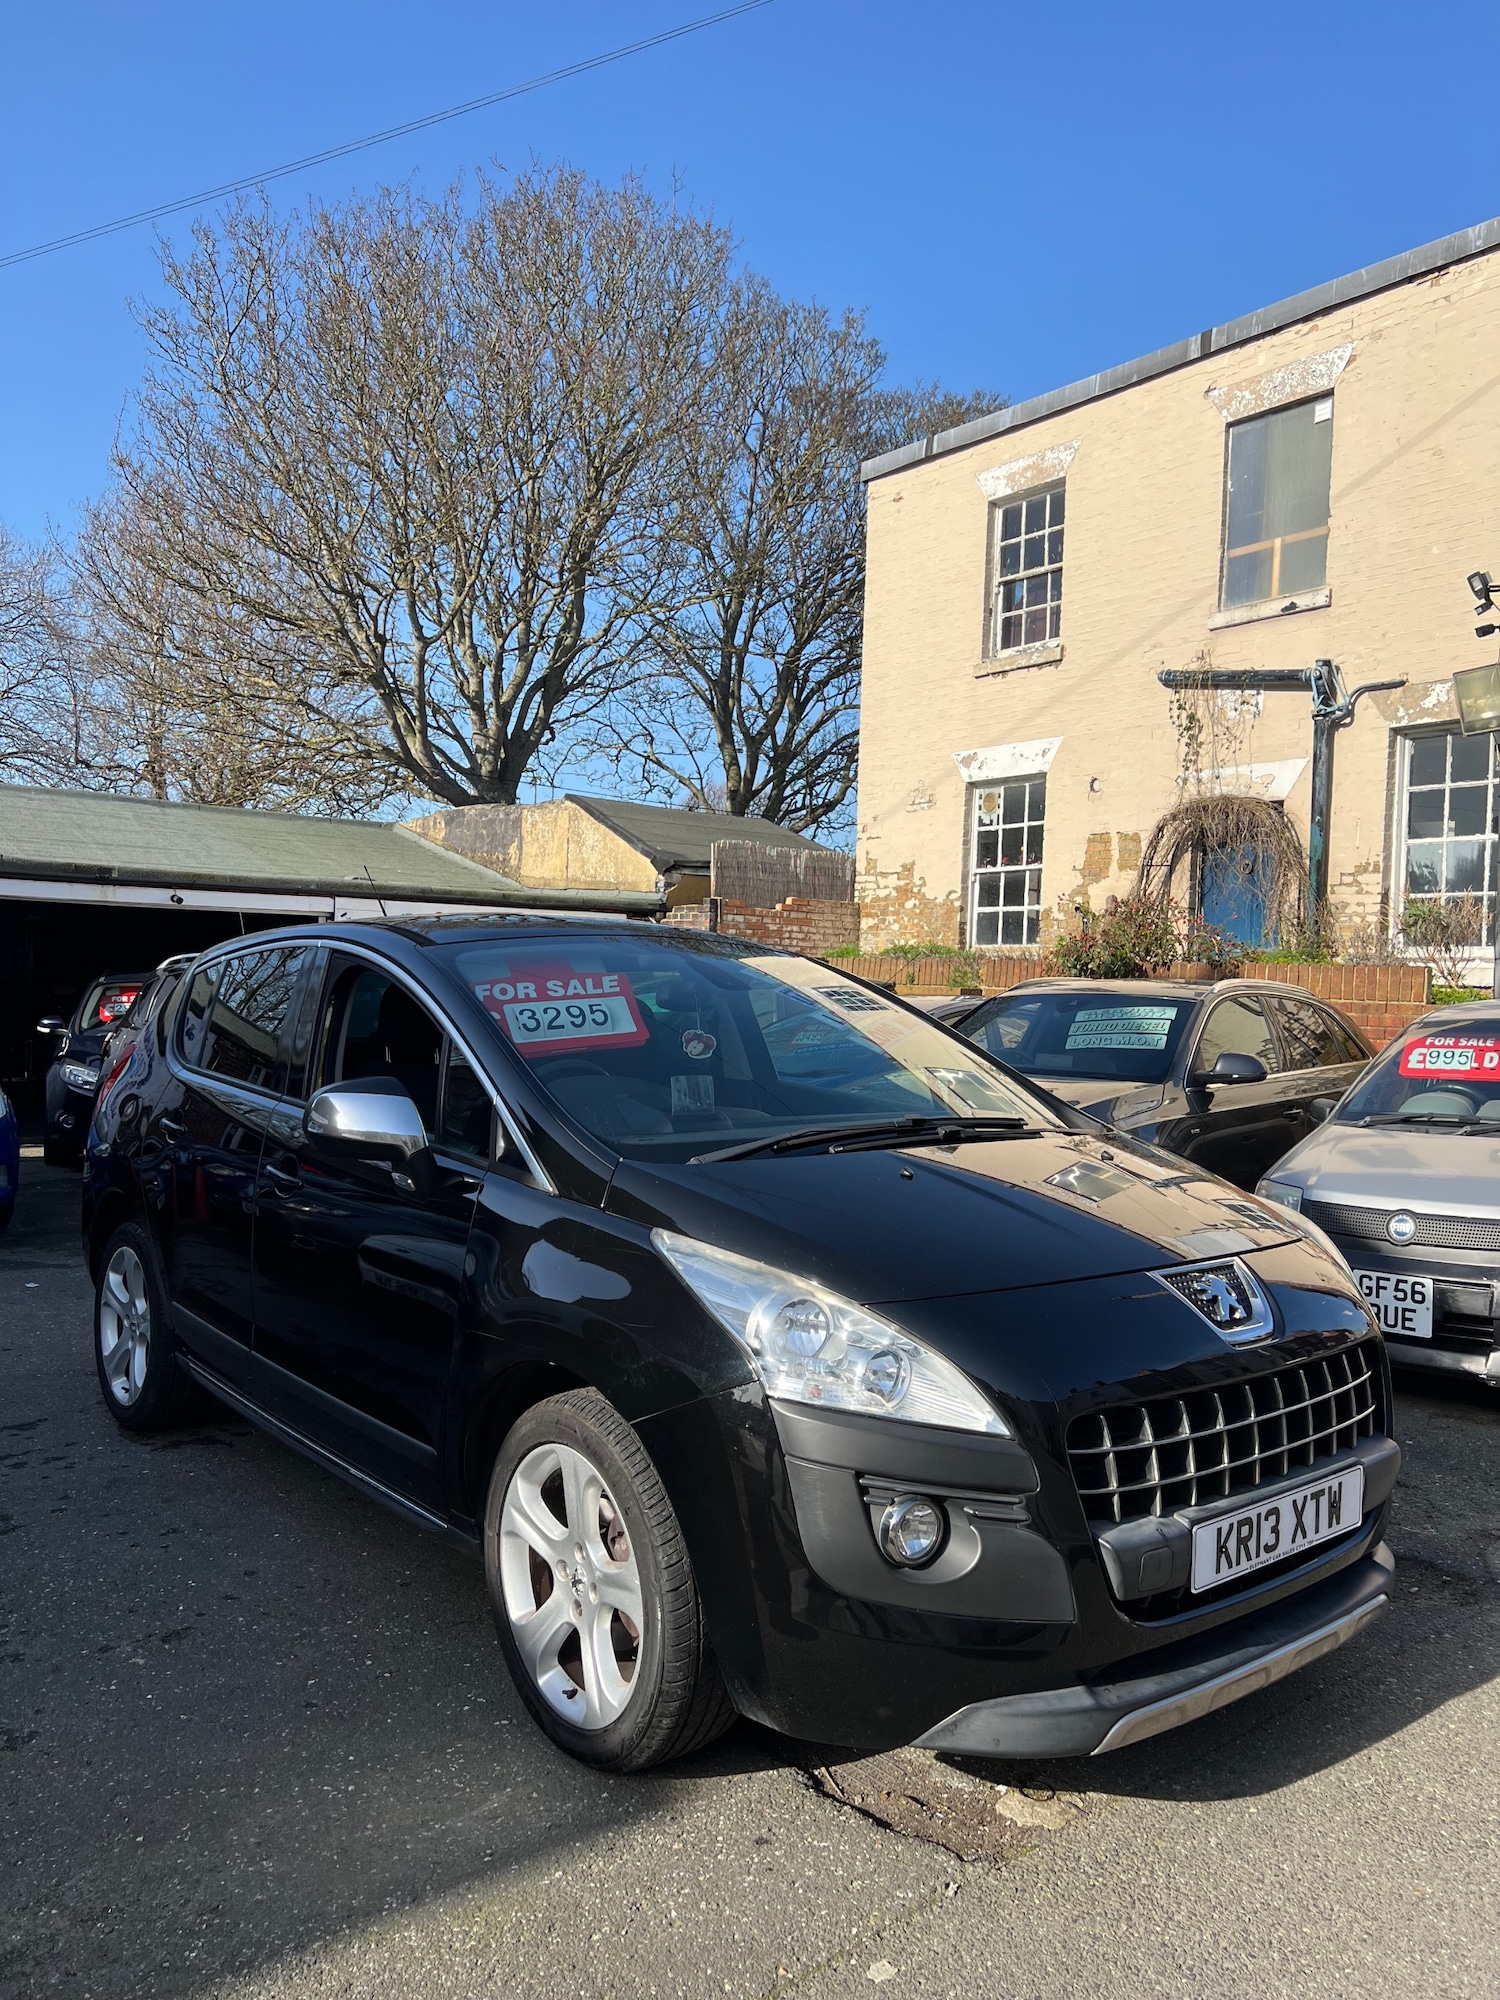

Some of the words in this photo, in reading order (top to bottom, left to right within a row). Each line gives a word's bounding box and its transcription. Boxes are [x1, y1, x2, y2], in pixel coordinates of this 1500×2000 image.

[474, 982, 538, 1001] FOR
[546, 974, 620, 997] SALE
[518, 1003, 609, 1033] 3295
[1072, 1022, 1117, 1034] TURBO
[1120, 1021, 1166, 1032] DIESEL
[1070, 1036, 1113, 1047] LONG
[1425, 1037, 1456, 1046] FOR
[1458, 1037, 1496, 1047] SALE
[1359, 1274, 1426, 1305] GF56
[1216, 1506, 1281, 1574] KR13
[1291, 1481, 1342, 1545] XTW
